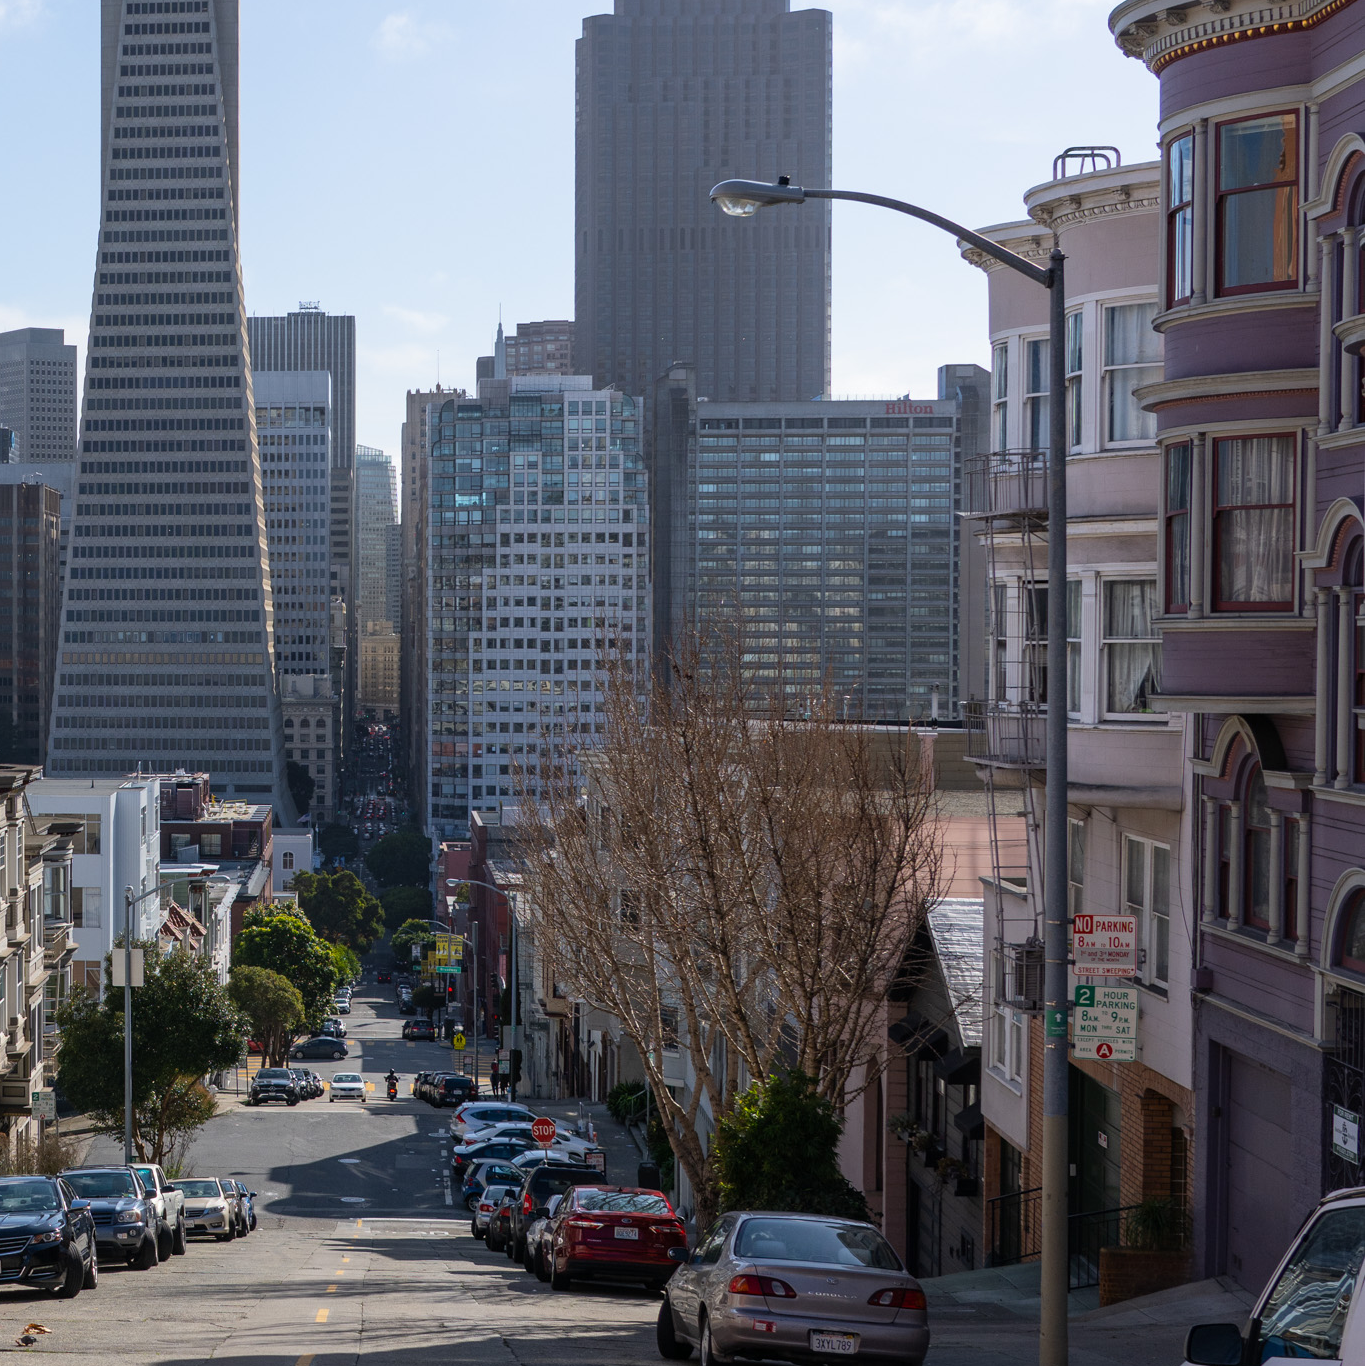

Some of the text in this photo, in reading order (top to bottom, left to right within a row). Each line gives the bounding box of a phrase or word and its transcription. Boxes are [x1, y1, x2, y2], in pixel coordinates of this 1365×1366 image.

[886, 401, 933, 414] Hilton
[1075, 916, 1134, 933] NO PARKING
[1079, 988, 1091, 1004] 2
[1103, 991, 1129, 1000] HOUR
[1096, 1000, 1136, 1010] PARKING
[1080, 1024, 1097, 1032] MON
[1116, 1026, 1131, 1034] SAT
[1098, 1044, 1110, 1056] A
[534, 1125, 555, 1136] STOP
[808, 1291, 857, 1299] COROLLA
[815, 1338, 852, 1351] 3XYL789
